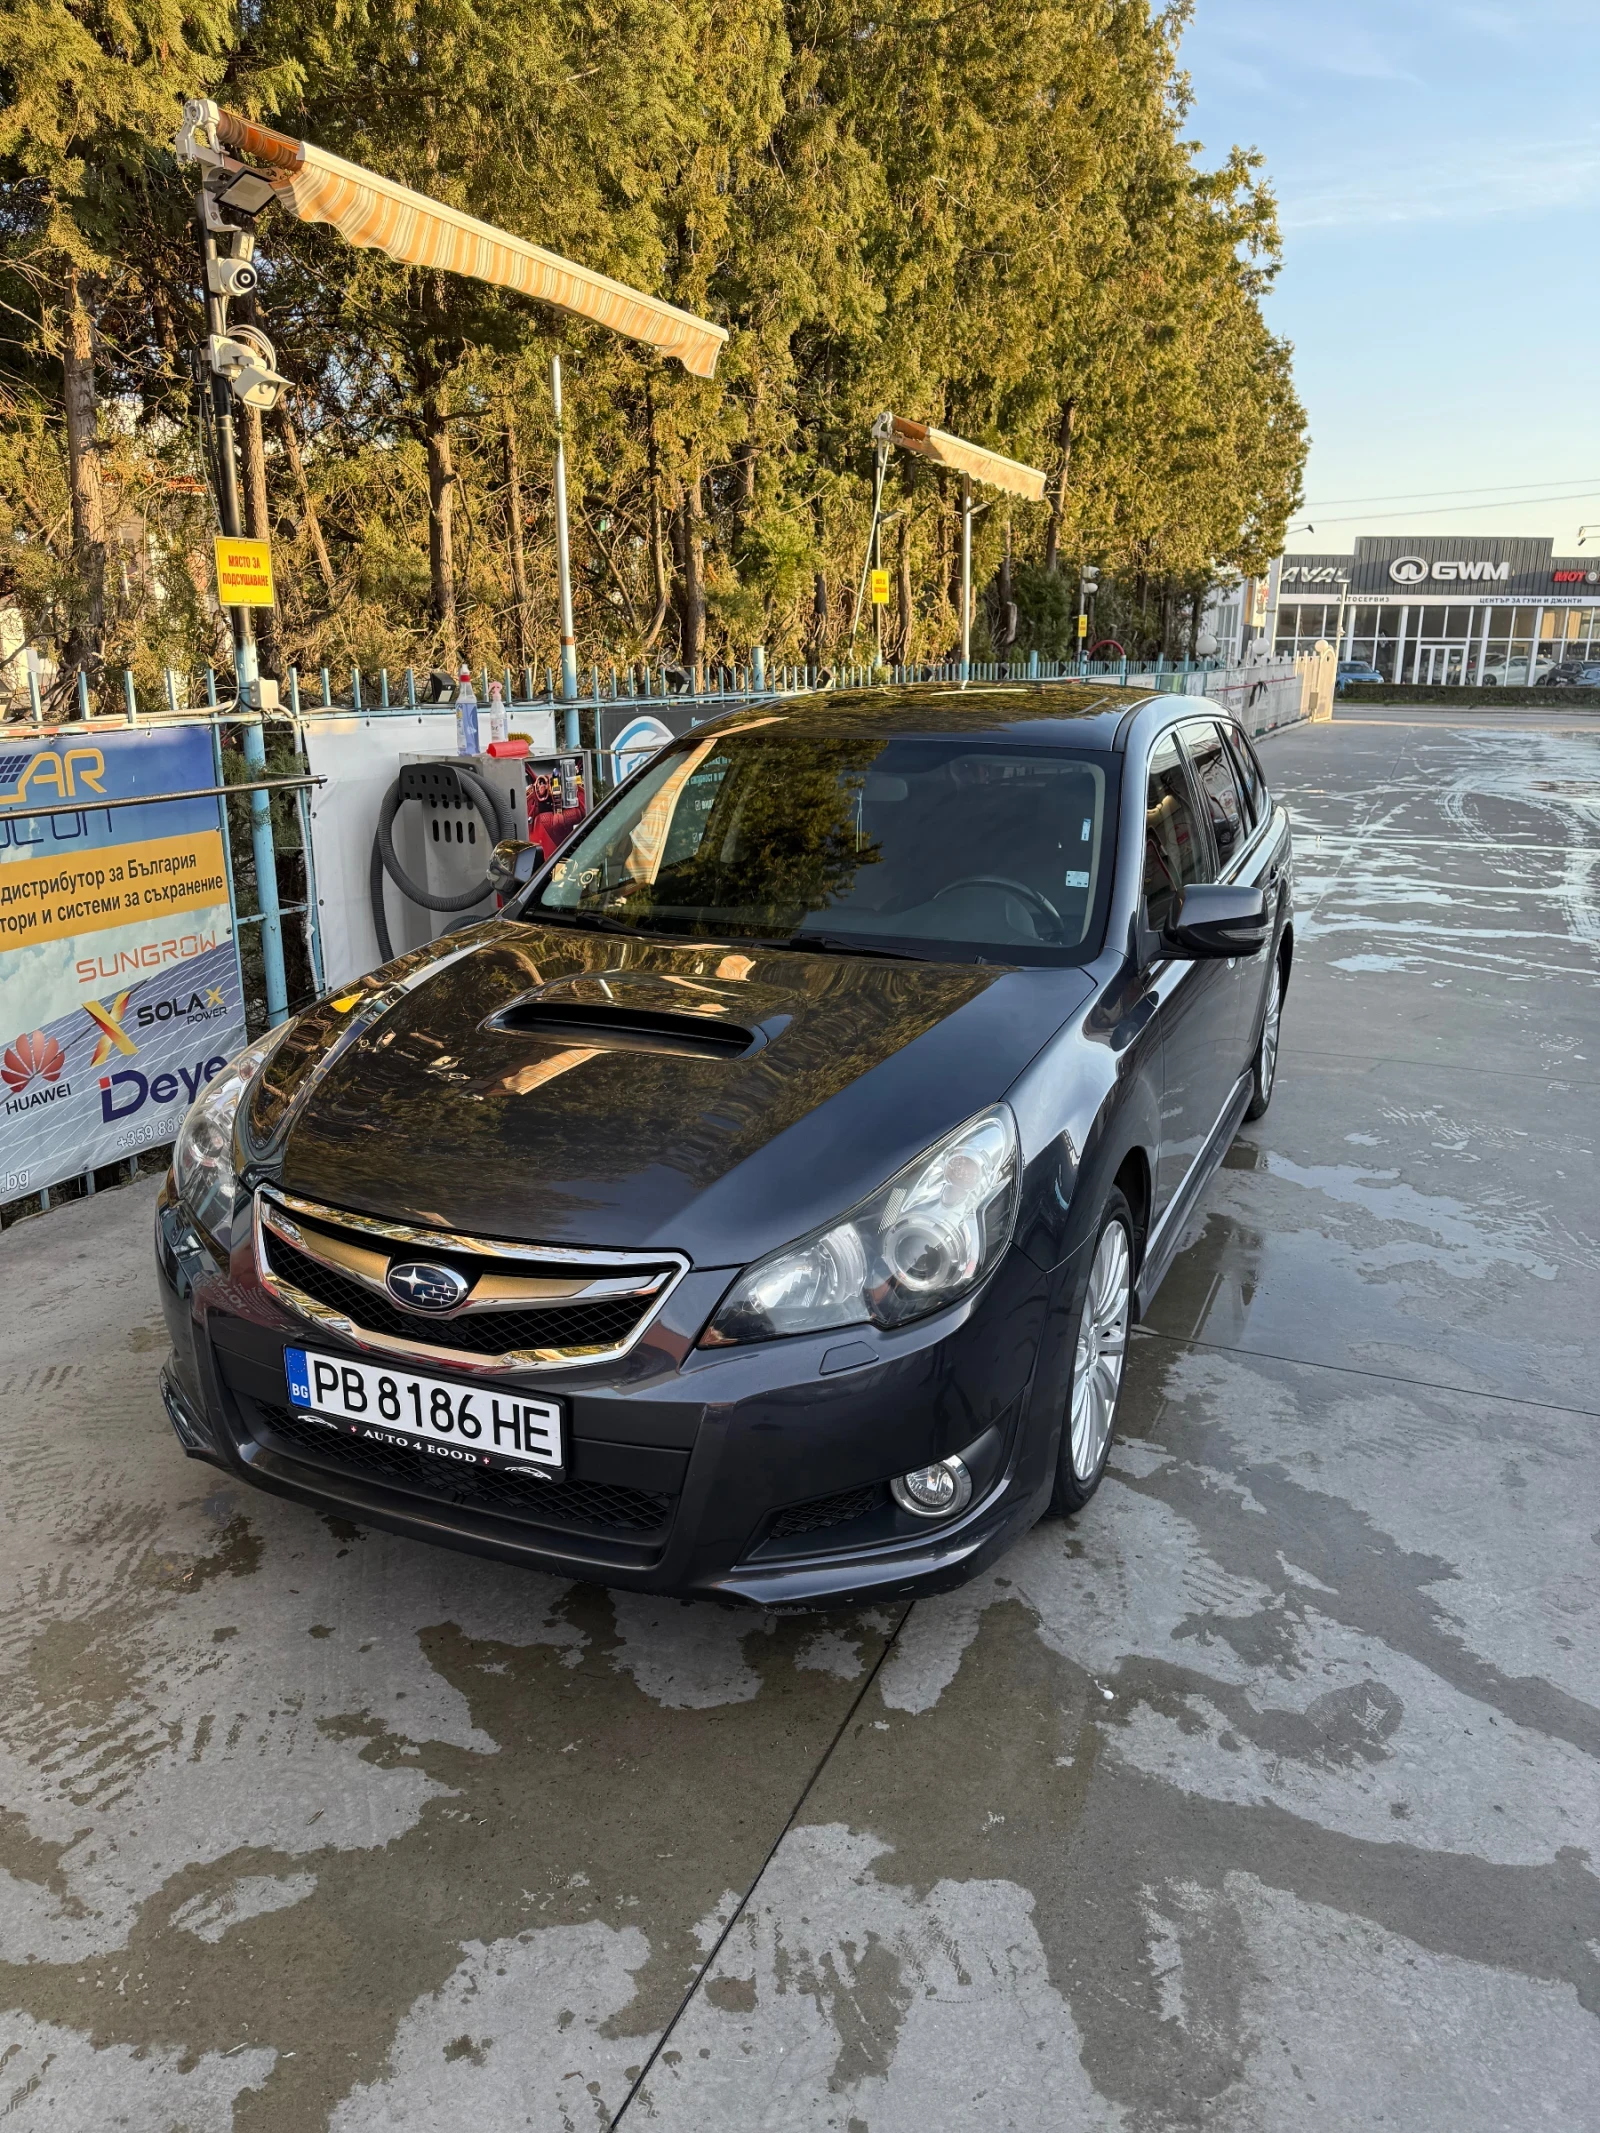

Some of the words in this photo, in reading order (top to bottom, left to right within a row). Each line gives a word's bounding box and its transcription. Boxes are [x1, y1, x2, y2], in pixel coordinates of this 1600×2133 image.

[228, 555, 250, 568] МЯСТО
[253, 557, 261, 568] ЗА
[1281, 566, 1352, 582] AVAL
[1430, 560, 1510, 581] GWM
[222, 573, 269, 587] ПОДСУШАВАНЕ
[1, 870, 105, 905] дистрибутор
[109, 866, 124, 882] за
[128, 853, 197, 879] България
[0, 911, 37, 934] тори
[42, 908, 52, 924] и
[57, 895, 121, 921] системи
[124, 891, 141, 908] за
[144, 875, 223, 903] съхранение
[76, 930, 217, 983] SUNGROW
[137, 986, 225, 1027] SOLAX
[187, 1006, 228, 1025] POWER
[6, 1083, 72, 1115] HUAWEI
[99, 1056, 228, 1123] Deye
[117, 1125, 154, 1149] +359
[157, 1117, 175, 1137] 88
[177, 1111, 188, 1129] 9
[1, 1169, 30, 1193] .bg
[292, 1384, 308, 1399] BG
[313, 1360, 368, 1413] PB
[378, 1376, 482, 1439] 8186
[492, 1399, 553, 1457] HE
[363, 1429, 408, 1448] AUTO
[412, 1441, 422, 1451] 4
[427, 1443, 477, 1463] EOOD
